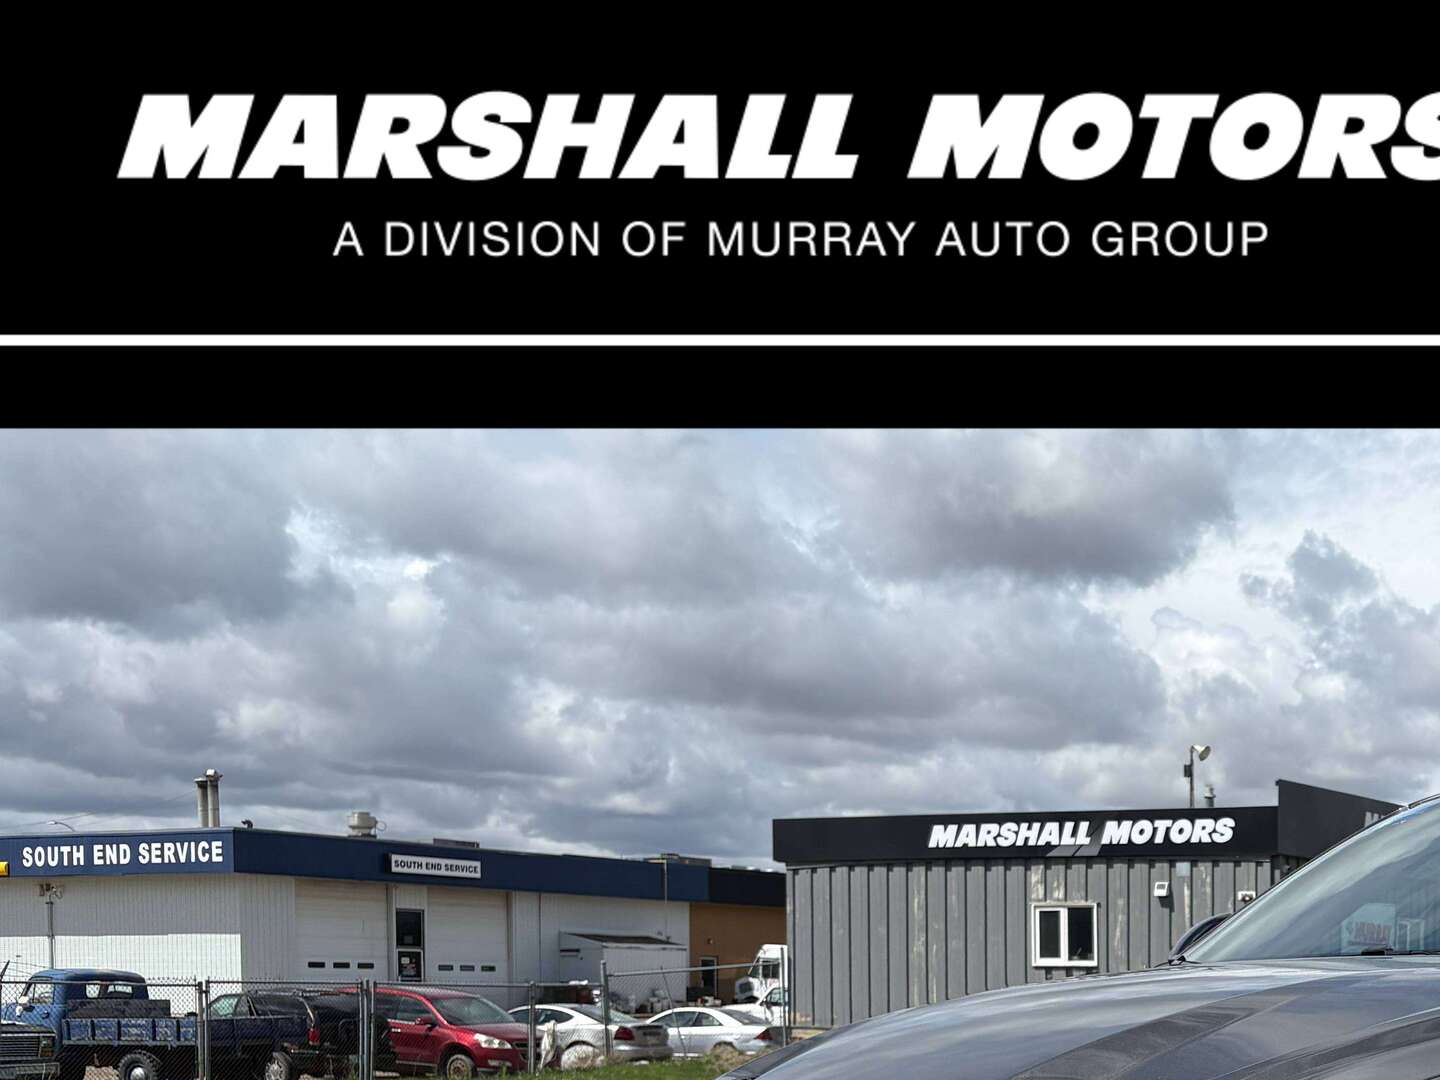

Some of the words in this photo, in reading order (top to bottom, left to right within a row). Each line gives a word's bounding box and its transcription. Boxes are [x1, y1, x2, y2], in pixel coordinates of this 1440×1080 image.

[928, 820, 1091, 849] MARSHALL
[1101, 817, 1235, 845] MOTORS
[22, 845, 85, 868] SOUTH
[93, 843, 131, 865] END
[138, 840, 223, 864] SERVICE
[394, 859, 423, 870] SOUTH
[425, 862, 442, 871] END
[444, 863, 479, 874] SERVICE
